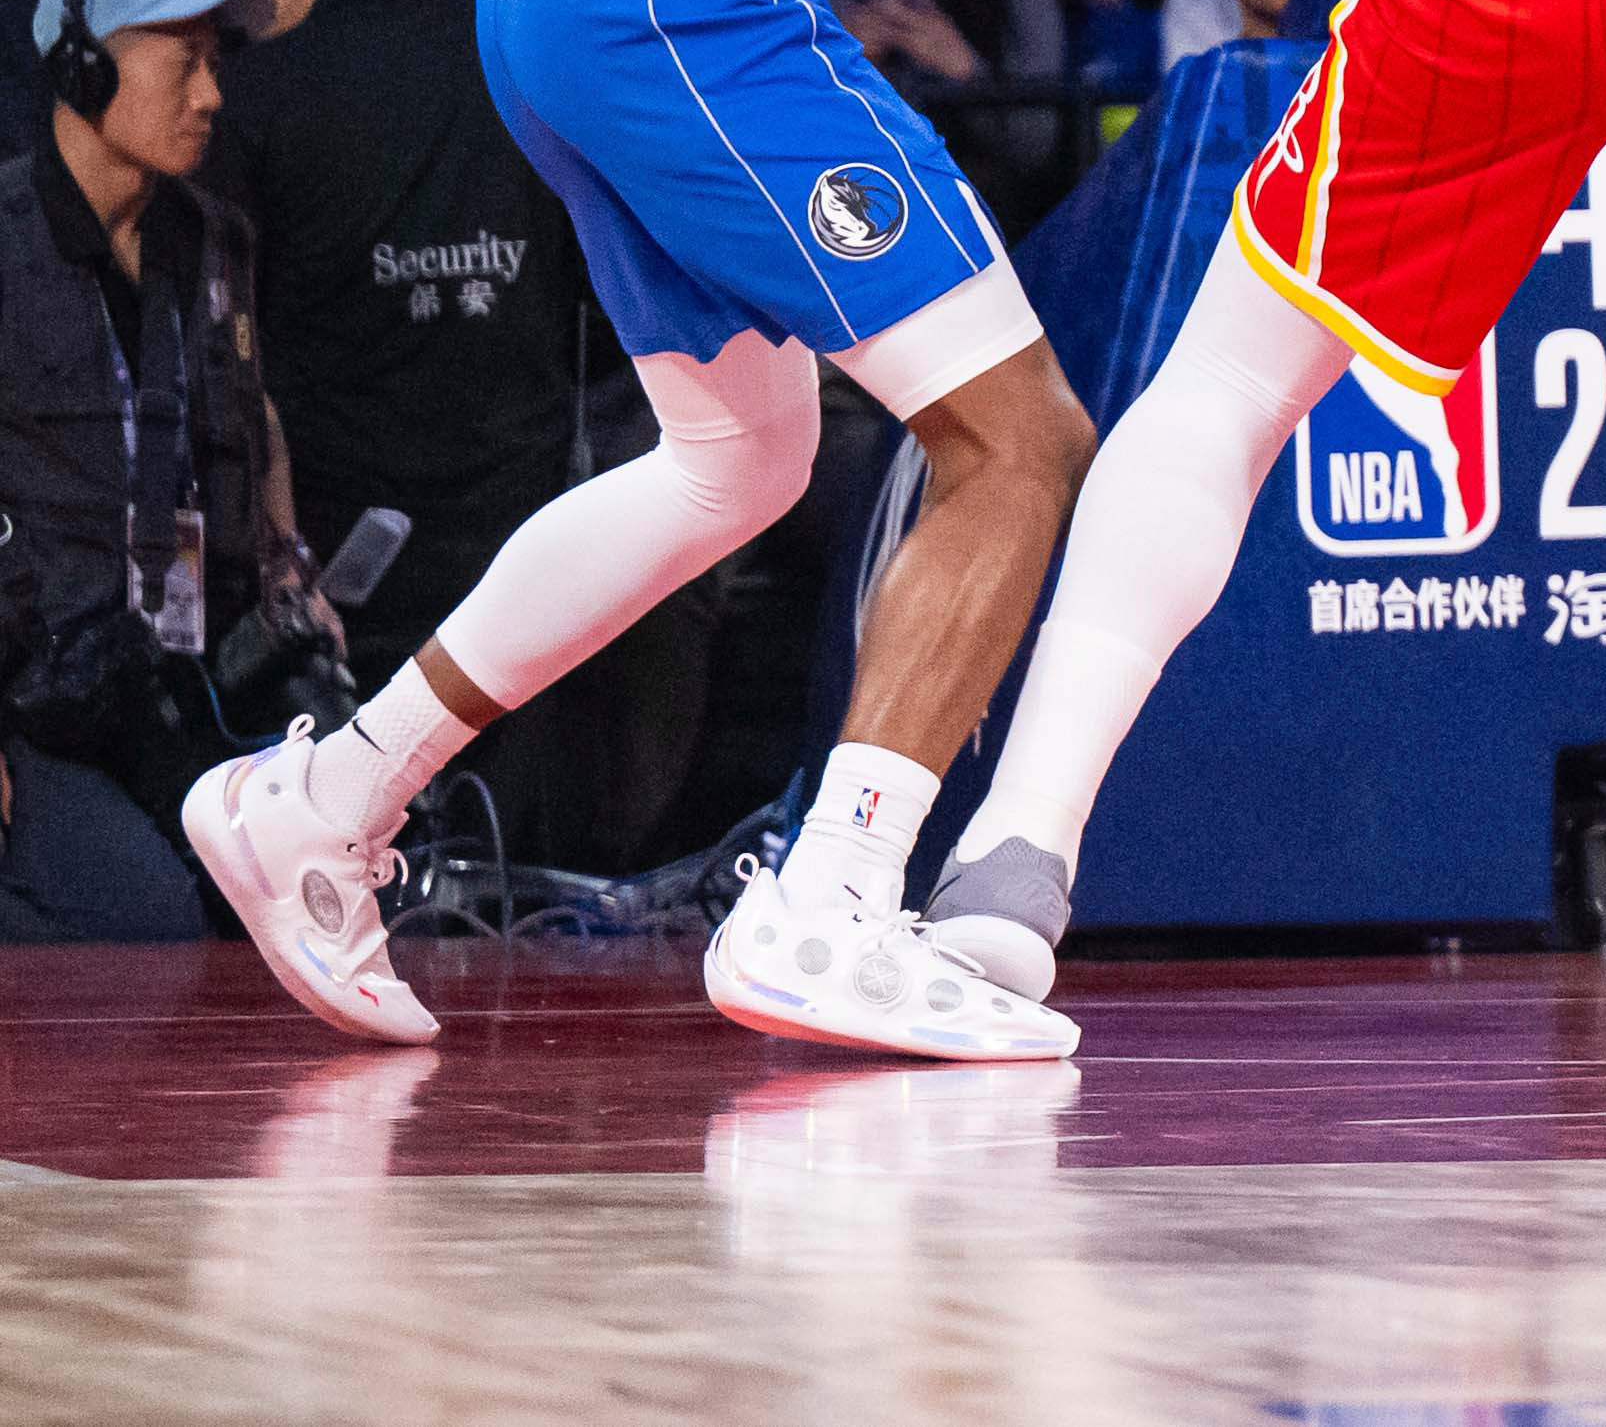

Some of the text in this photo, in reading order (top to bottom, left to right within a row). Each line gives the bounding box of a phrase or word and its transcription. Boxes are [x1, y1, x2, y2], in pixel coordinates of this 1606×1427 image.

[372, 228, 528, 284] Security
[1328, 449, 1424, 525] NBA
[1307, 573, 1527, 634] 首席合作伙伴
